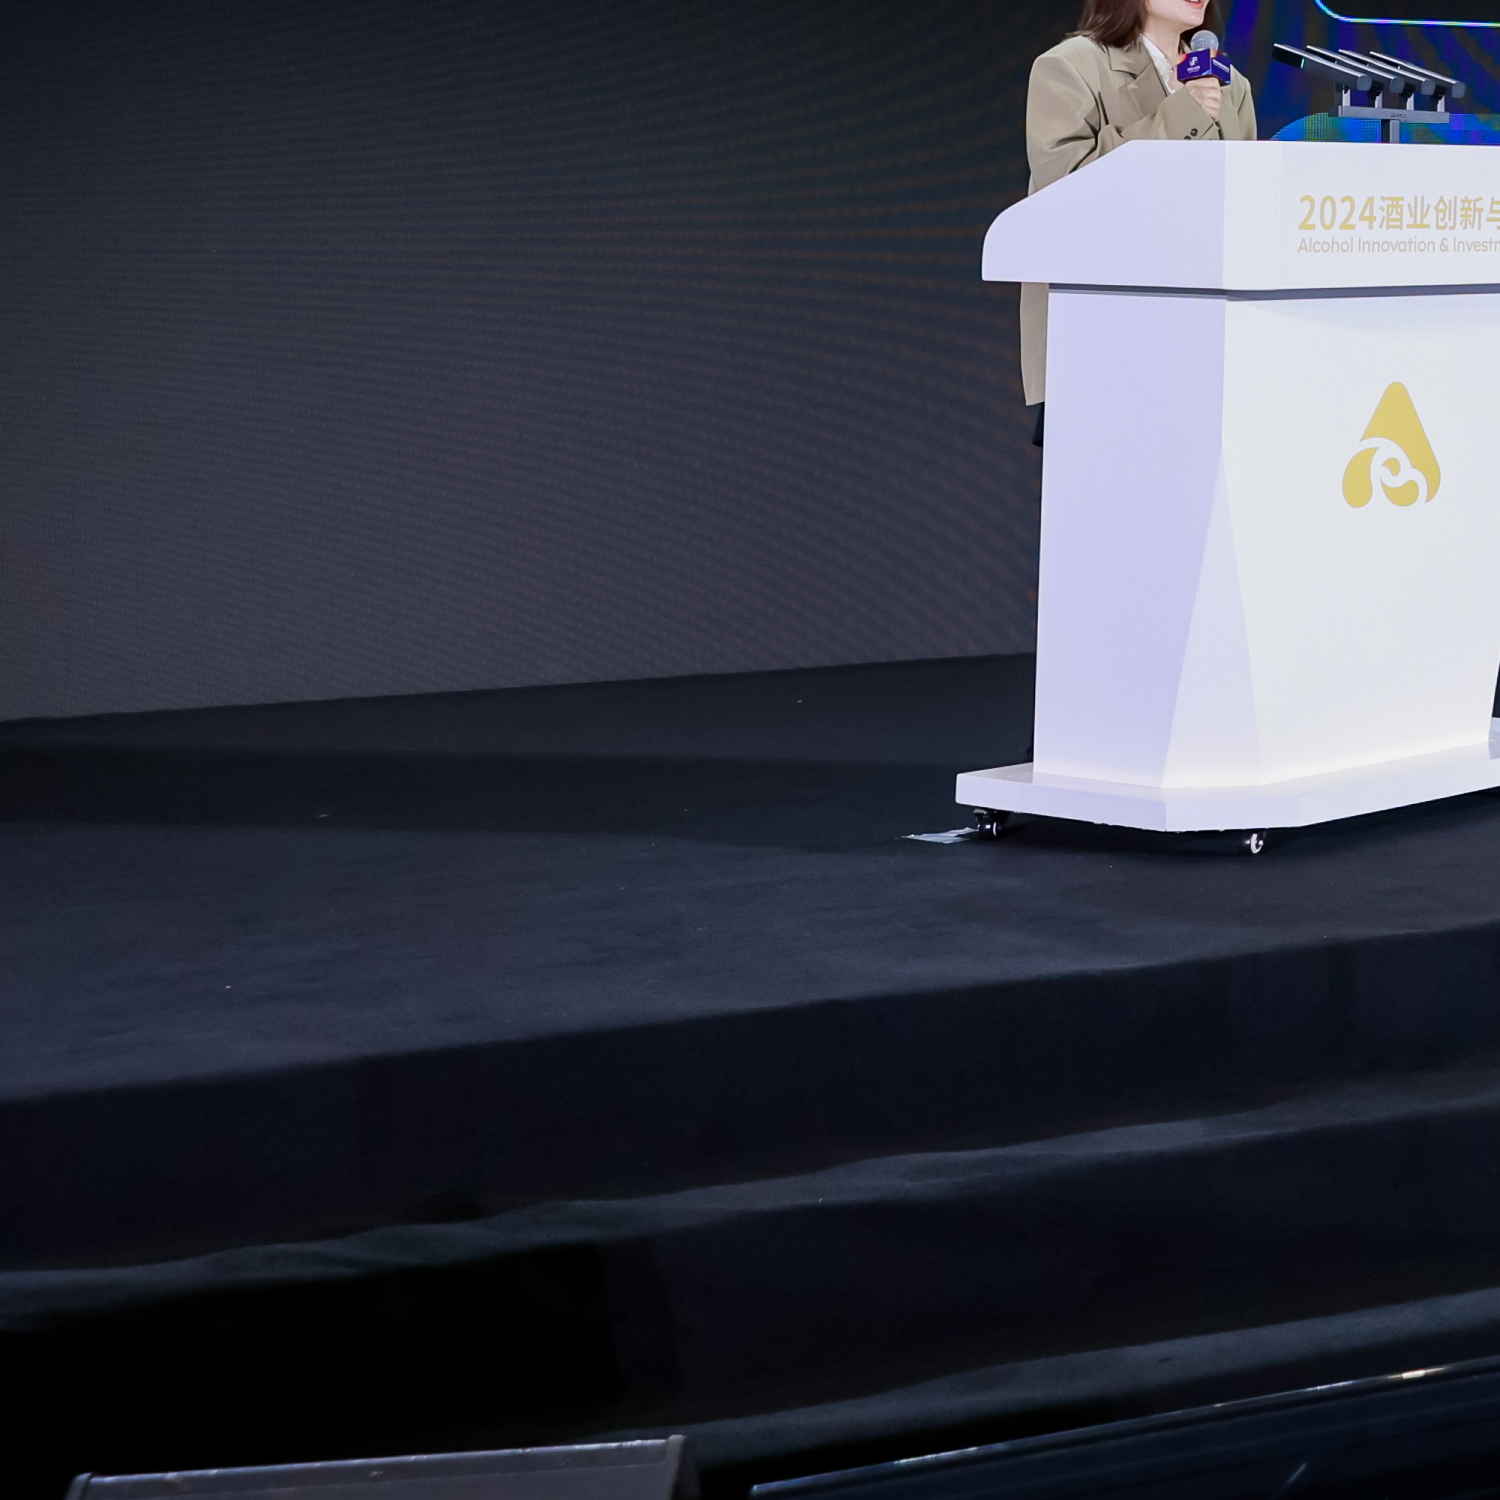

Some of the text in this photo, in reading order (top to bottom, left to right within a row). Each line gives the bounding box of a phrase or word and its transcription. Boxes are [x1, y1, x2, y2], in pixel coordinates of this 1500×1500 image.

[1298, 236, 1354, 253] Alcohol
[1357, 236, 1436, 253] Innovation
[1439, 237, 1450, 252] &
